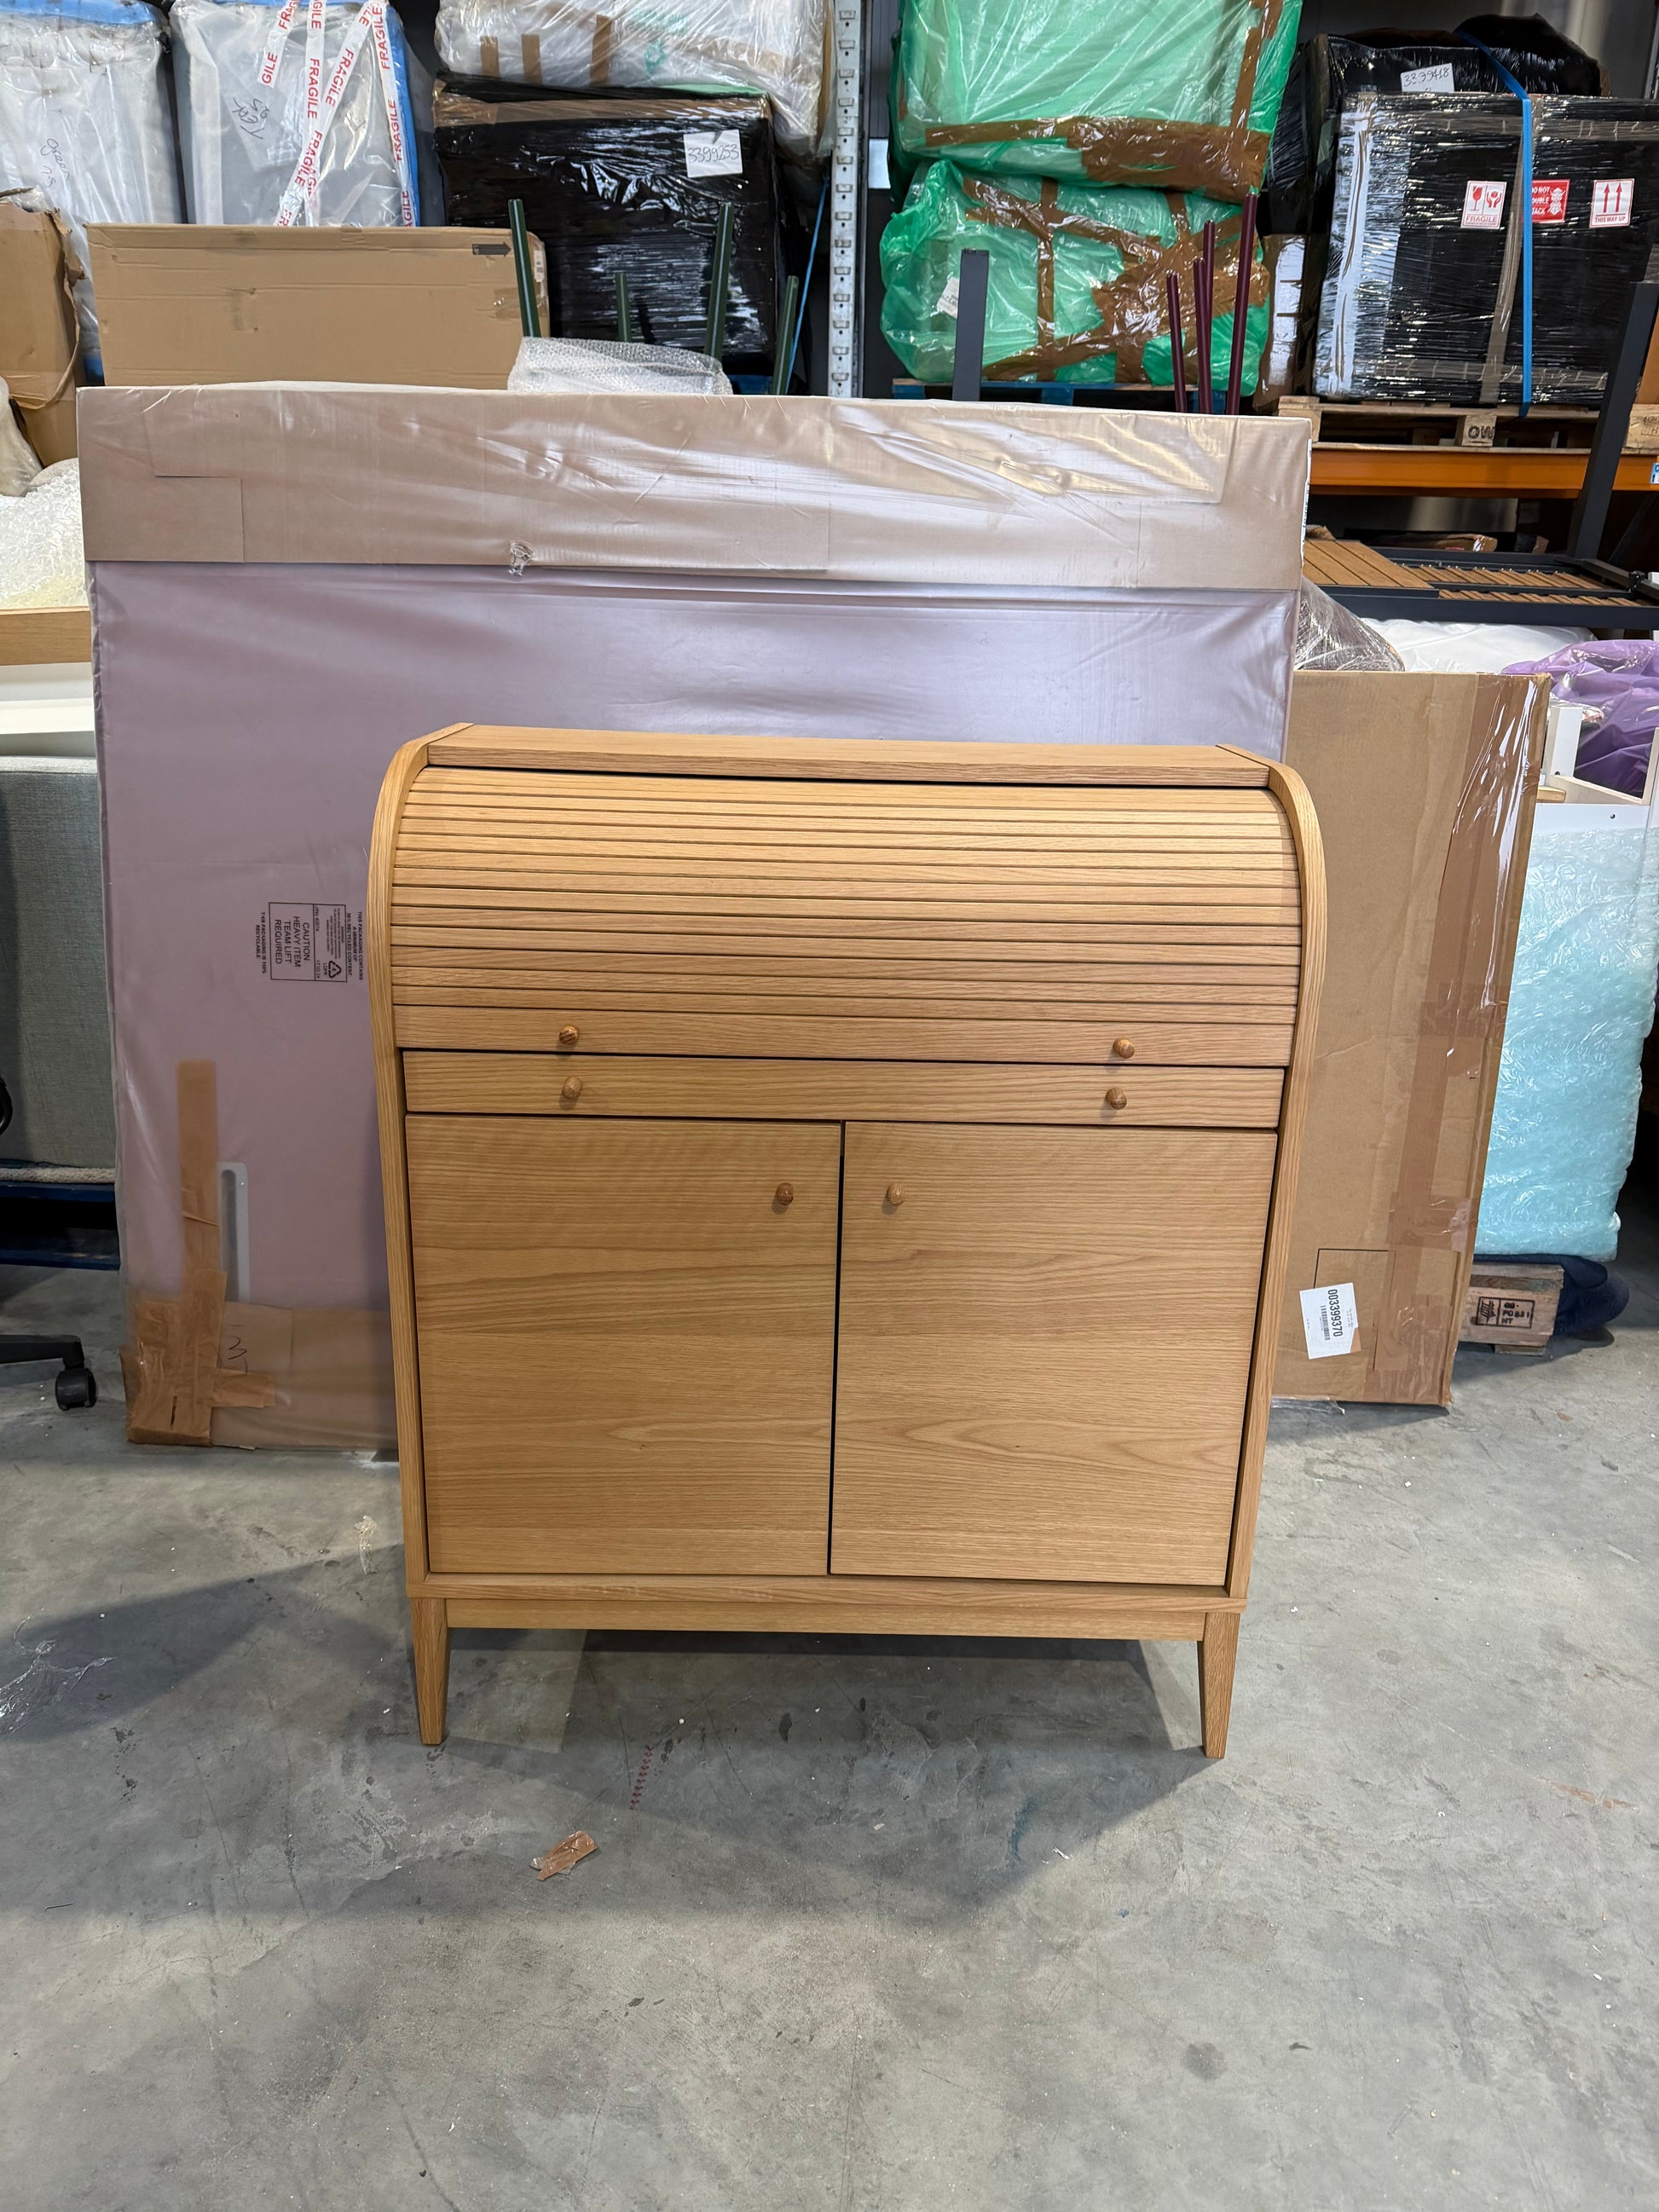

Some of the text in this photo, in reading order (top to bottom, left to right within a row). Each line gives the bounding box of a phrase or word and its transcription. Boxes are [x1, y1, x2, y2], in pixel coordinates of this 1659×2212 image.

[279, 0, 298, 30] FRAG
[311, 0, 322, 29] GILE
[373, 6, 390, 70] FRAGILE
[262, 52, 278, 84] GILE
[307, 58, 321, 119] FRAGILE
[325, 49, 354, 107] FRAGILE
[388, 99, 402, 161] FRAGILE
[294, 130, 323, 187] FRAGILE
[687, 143, 740, 164] 3399253
[1538, 186, 1551, 194] NOT
[274, 919, 282, 965] REQUIRED
[302, 921, 310, 962] CAUTION
[1327, 1289, 1344, 1337] 003399370
